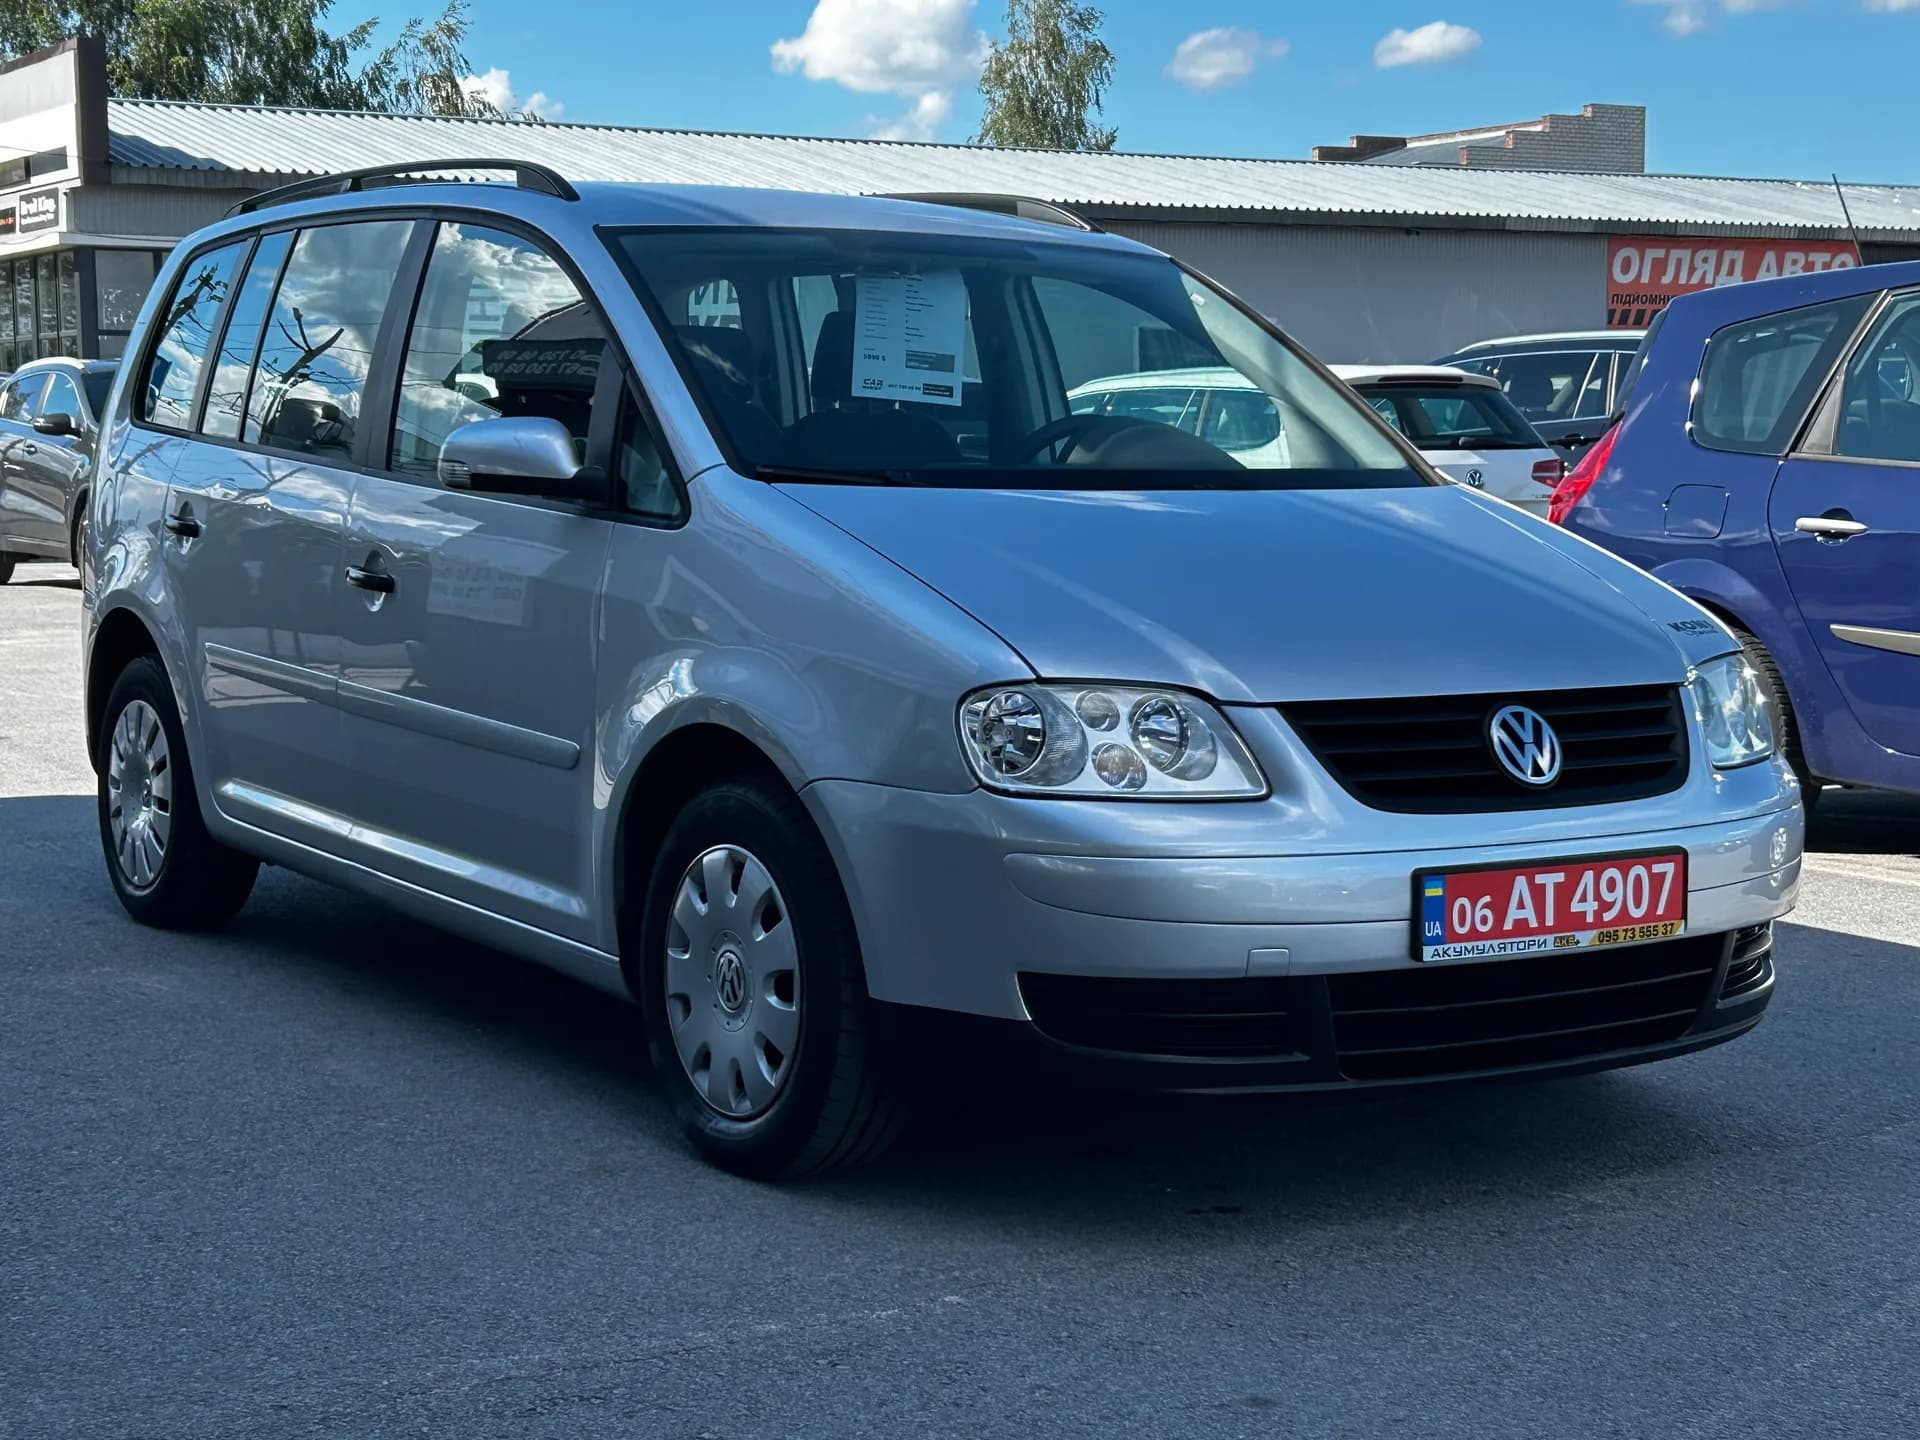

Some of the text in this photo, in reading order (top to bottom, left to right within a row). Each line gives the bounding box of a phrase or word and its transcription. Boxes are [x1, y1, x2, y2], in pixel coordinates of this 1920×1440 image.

[1612, 247, 1745, 286] ОГЛЯД
[1611, 292, 1677, 306] ПІДЙОМН
[1452, 862, 1675, 934] 06 AT 4907
[1425, 921, 1442, 937] UA
[1430, 938, 1547, 959] АКУМУЛЯТОРИ
[1597, 930, 1619, 943] 095
[1622, 927, 1636, 941] 73
[1639, 924, 1659, 939] 555
[1661, 922, 1676, 935] 37
